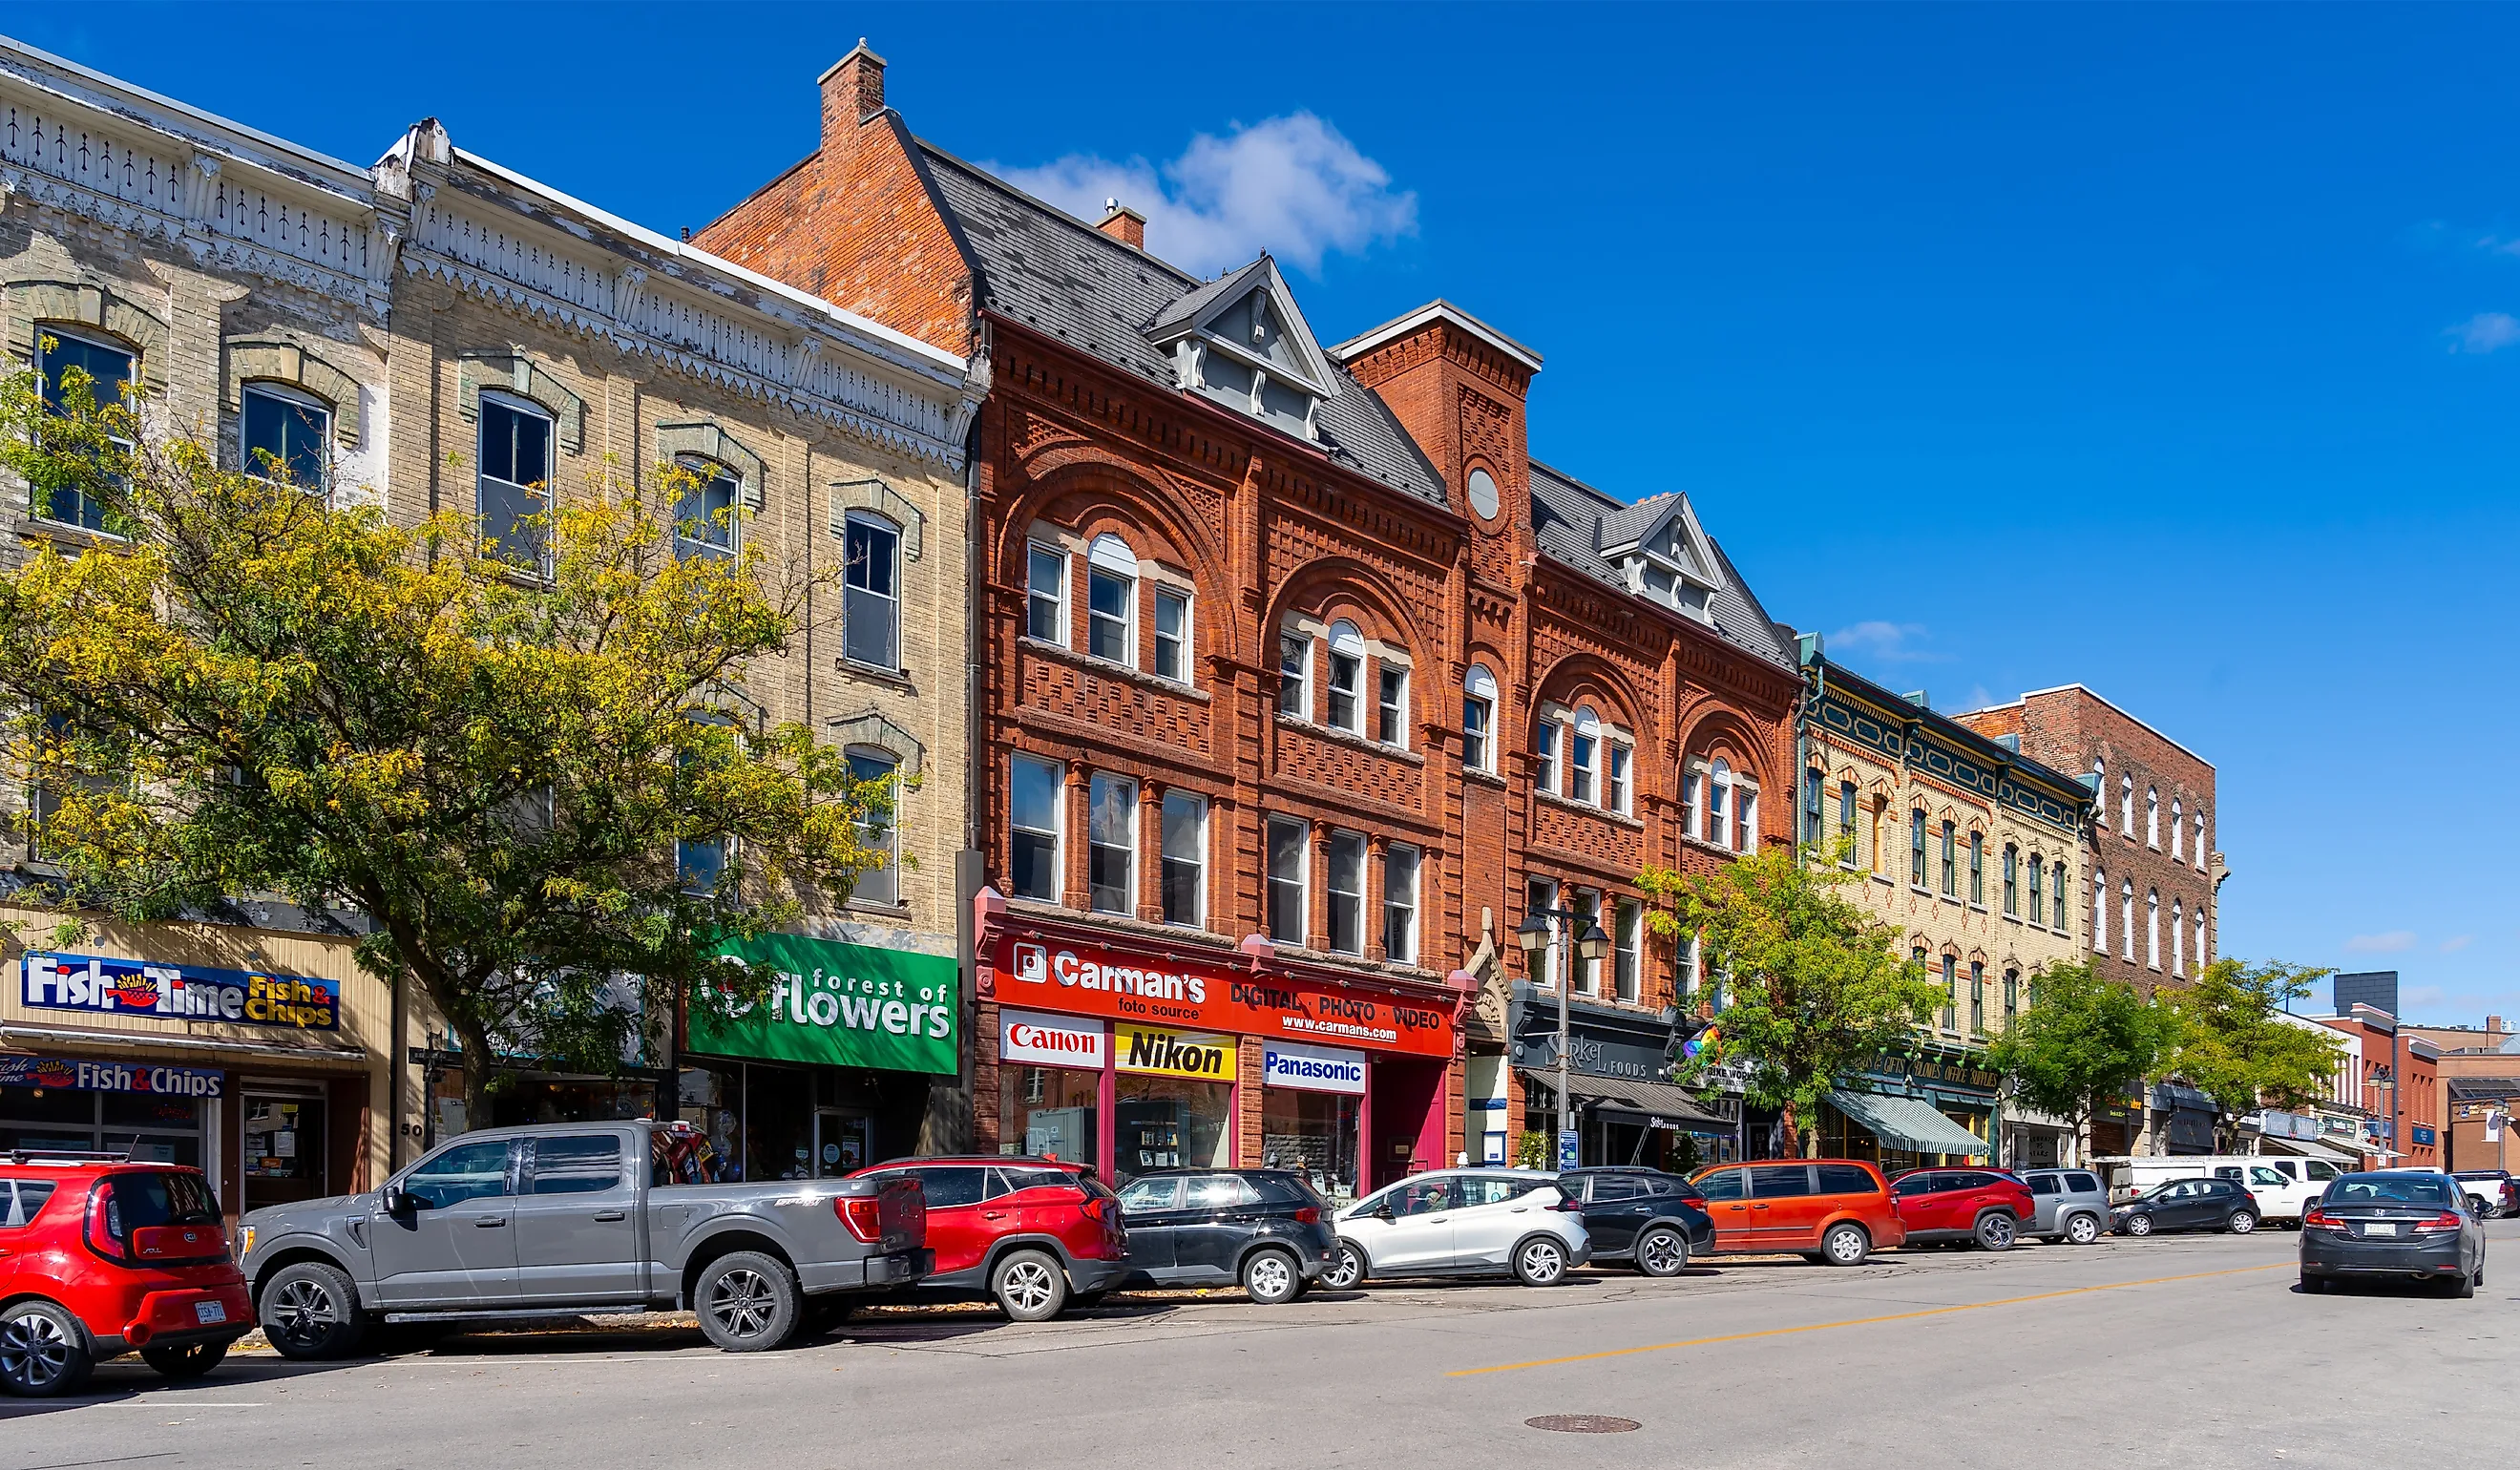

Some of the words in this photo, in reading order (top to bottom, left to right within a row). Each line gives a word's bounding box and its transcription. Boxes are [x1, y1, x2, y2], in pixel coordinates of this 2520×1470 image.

[27, 956, 116, 1009] Fish
[143, 966, 243, 1018] Time
[249, 976, 311, 1002] Fish
[312, 985, 330, 1004] &
[812, 968, 904, 998] forest
[919, 984, 947, 1002] of
[1054, 950, 1207, 1004] Carman's
[244, 998, 331, 1028] Chips
[771, 971, 951, 1039] flowers
[1118, 998, 1146, 1014] foto
[1151, 1004, 1200, 1020] source
[1229, 982, 1301, 1011] DIGITAL
[1318, 997, 1376, 1021] PHOTO
[1392, 1005, 1439, 1030] VIDEO
[1010, 1023, 1096, 1054] Canon
[1282, 1016, 1396, 1040] www.carmans.com
[1128, 1031, 1223, 1074] Nikon
[1266, 1051, 1361, 1082] Panasonic
[1883, 1056, 1905, 1074] GIFTS
[77, 1061, 131, 1090] Fish
[131, 1068, 150, 1090] &
[151, 1067, 220, 1097] Chips
[1610, 1060, 1648, 1078] FOODS
[1708, 1067, 1727, 1078] BIKE
[1914, 1060, 1942, 1080] BLOWES
[1944, 1065, 1968, 1084] OFFICE
[1970, 1067, 1999, 1087] SUPPLIES
[401, 1123, 423, 1137] 50
